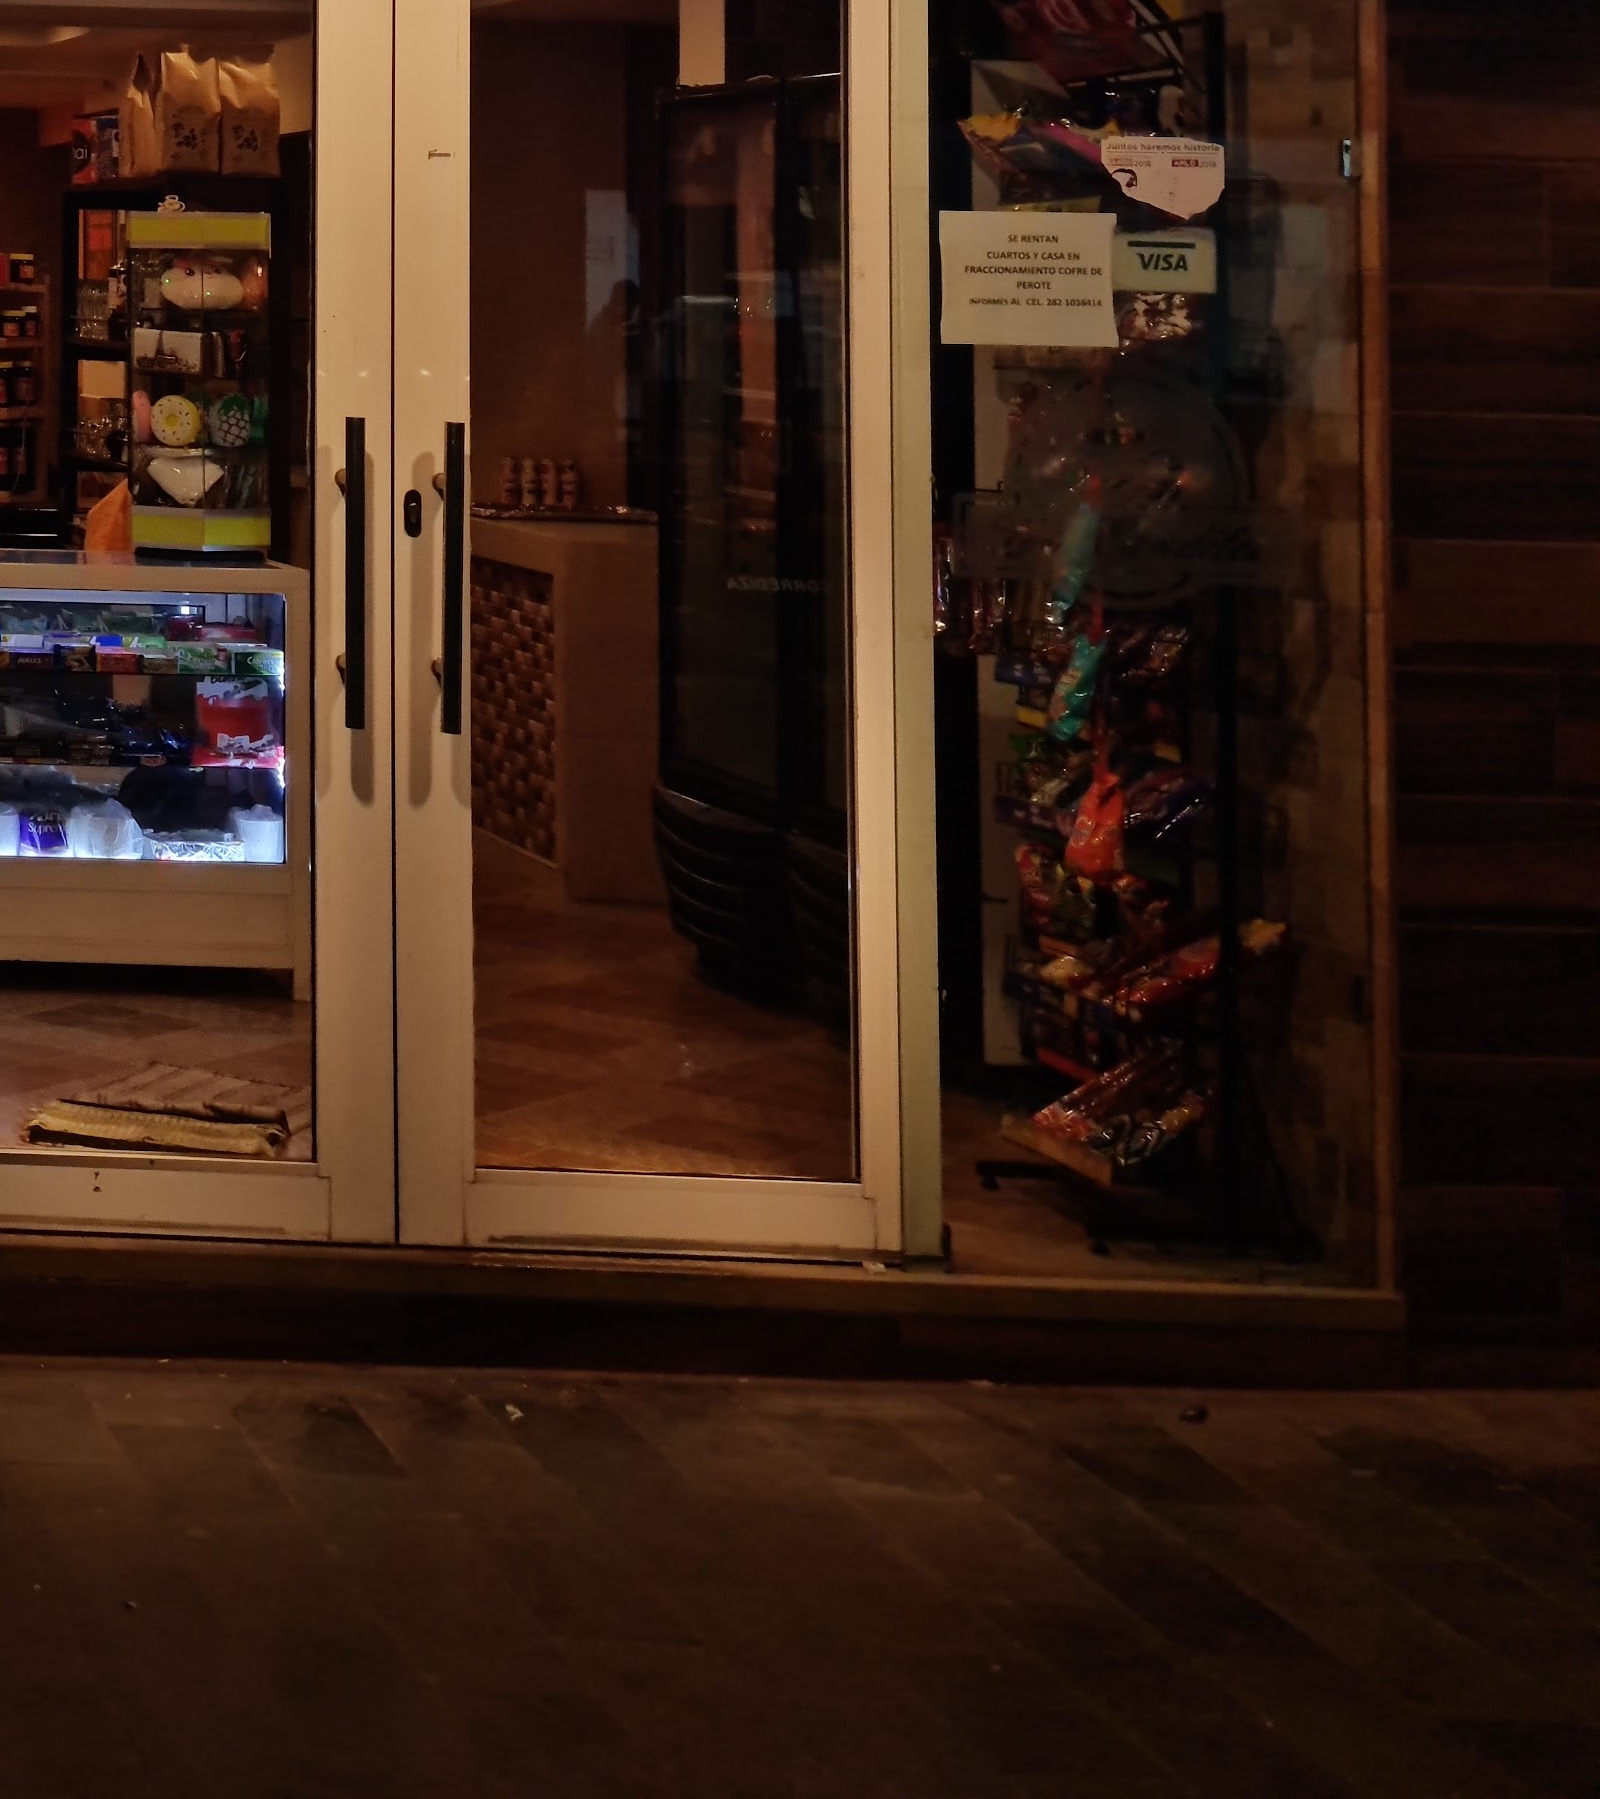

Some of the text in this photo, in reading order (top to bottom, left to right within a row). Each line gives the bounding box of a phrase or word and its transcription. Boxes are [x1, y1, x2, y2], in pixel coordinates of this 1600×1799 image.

[1106, 142, 1220, 152] Juntos haremos historia
[1008, 234, 1059, 243] SE RENTAN
[987, 251, 1081, 261] CUARTOS Y CASA EN
[1136, 253, 1189, 271] VISA
[964, 265, 1103, 276] FRACCIONAMIENTO COFRE DE
[1016, 281, 1052, 290] PEROTE
[969, 298, 1009, 306] INFORMES
[1010, 298, 1021, 306] AL
[1046, 298, 1062, 306] 282
